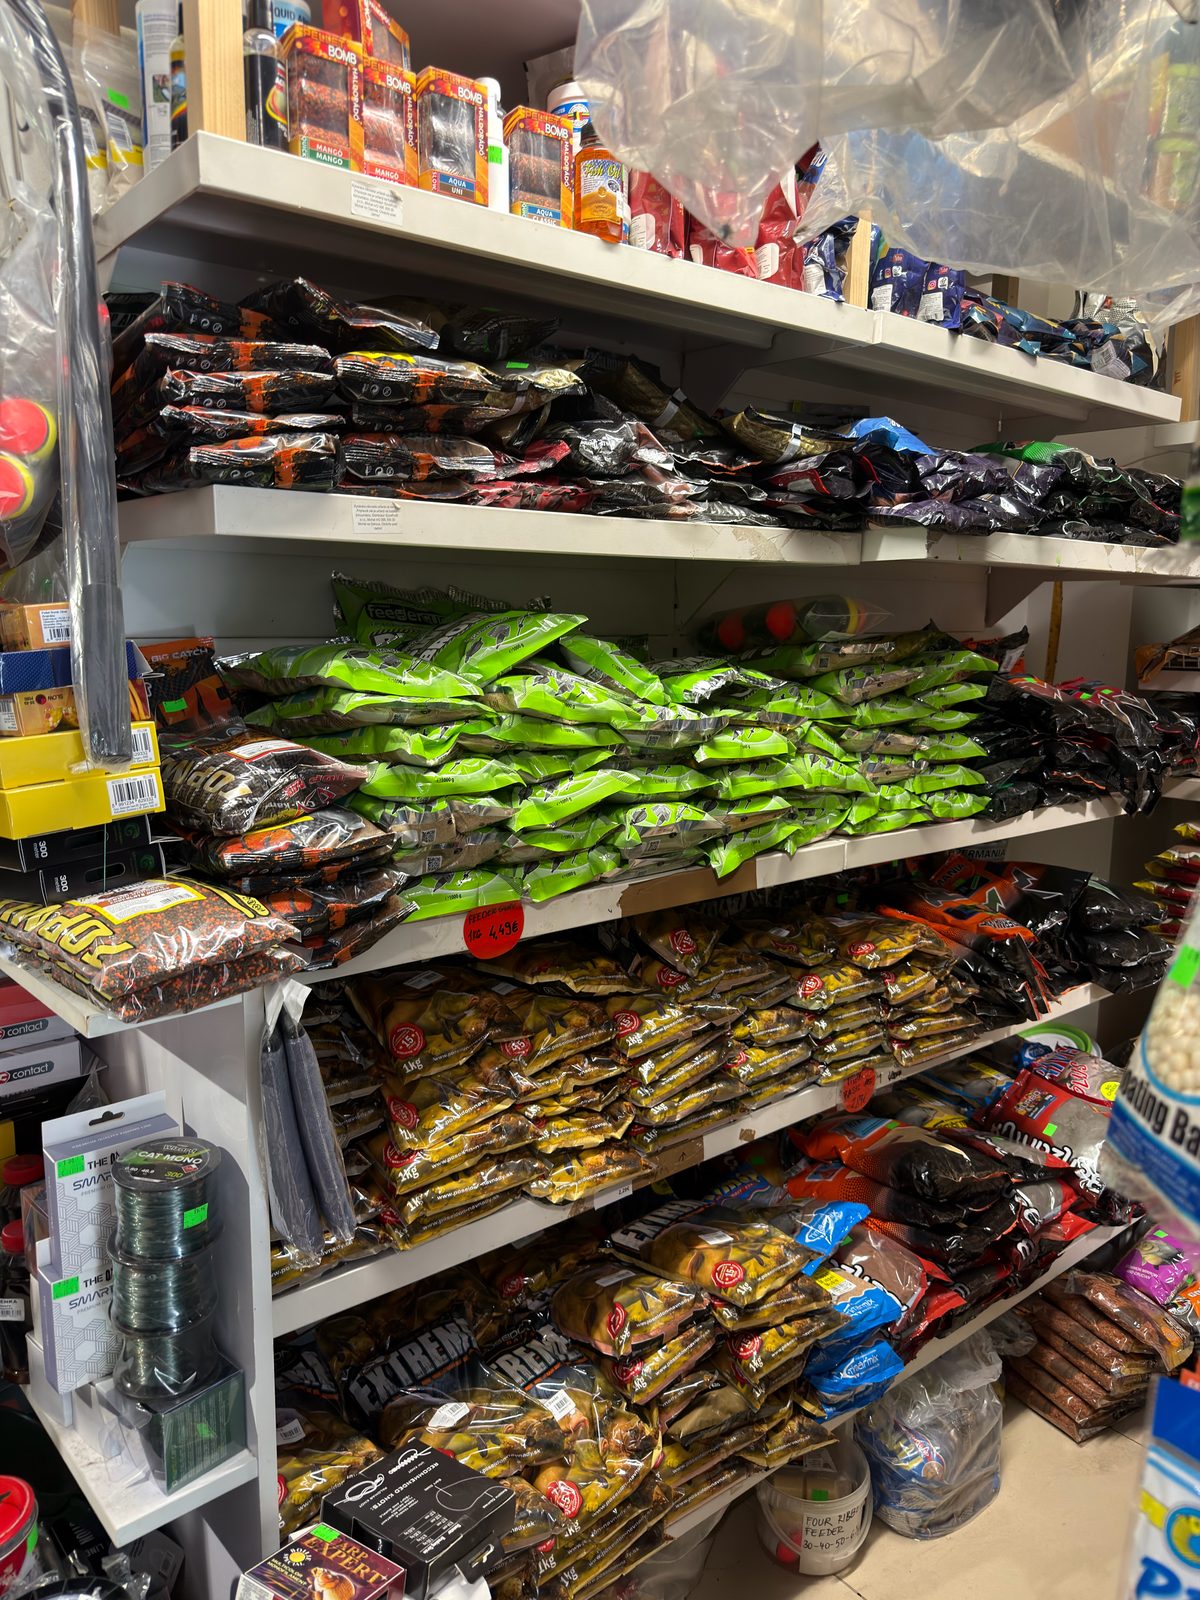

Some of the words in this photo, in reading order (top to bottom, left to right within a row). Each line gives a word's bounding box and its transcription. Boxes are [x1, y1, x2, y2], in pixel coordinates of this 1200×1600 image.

[274, 7, 296, 19] QUID
[328, 45, 357, 65] BOMB
[386, 75, 412, 94] BOMB
[458, 86, 483, 105] BOMB
[545, 123, 569, 139] BOMB
[448, 177, 467, 189] AQUA
[451, 186, 463, 196] UNI
[536, 208, 553, 218] AQUA
[38, 840, 48, 858] 300
[60, 875, 69, 892] 300
[7, 1020, 44, 1037] contact
[620, 1017, 631, 1028] 15
[402, 1036, 415, 1048] 15
[12, 1062, 49, 1080] contact
[402, 1057, 423, 1074] 1kg
[87, 1158, 108, 1171] THE
[138, 1150, 161, 1159] CAT
[163, 1153, 203, 1165] MONO
[725, 1267, 735, 1277] 15
[83, 1275, 104, 1288] THE
[736, 1282, 752, 1297] 1kg
[806, 1516, 833, 1527] FOUR
[805, 1526, 844, 1537] FEEDER
[302, 1536, 383, 1585] EXPERT
[538, 1554, 557, 1575] 1kg
[267, 1561, 308, 1586] MONOFILAMENT
[560, 1566, 579, 1587] 1kg
